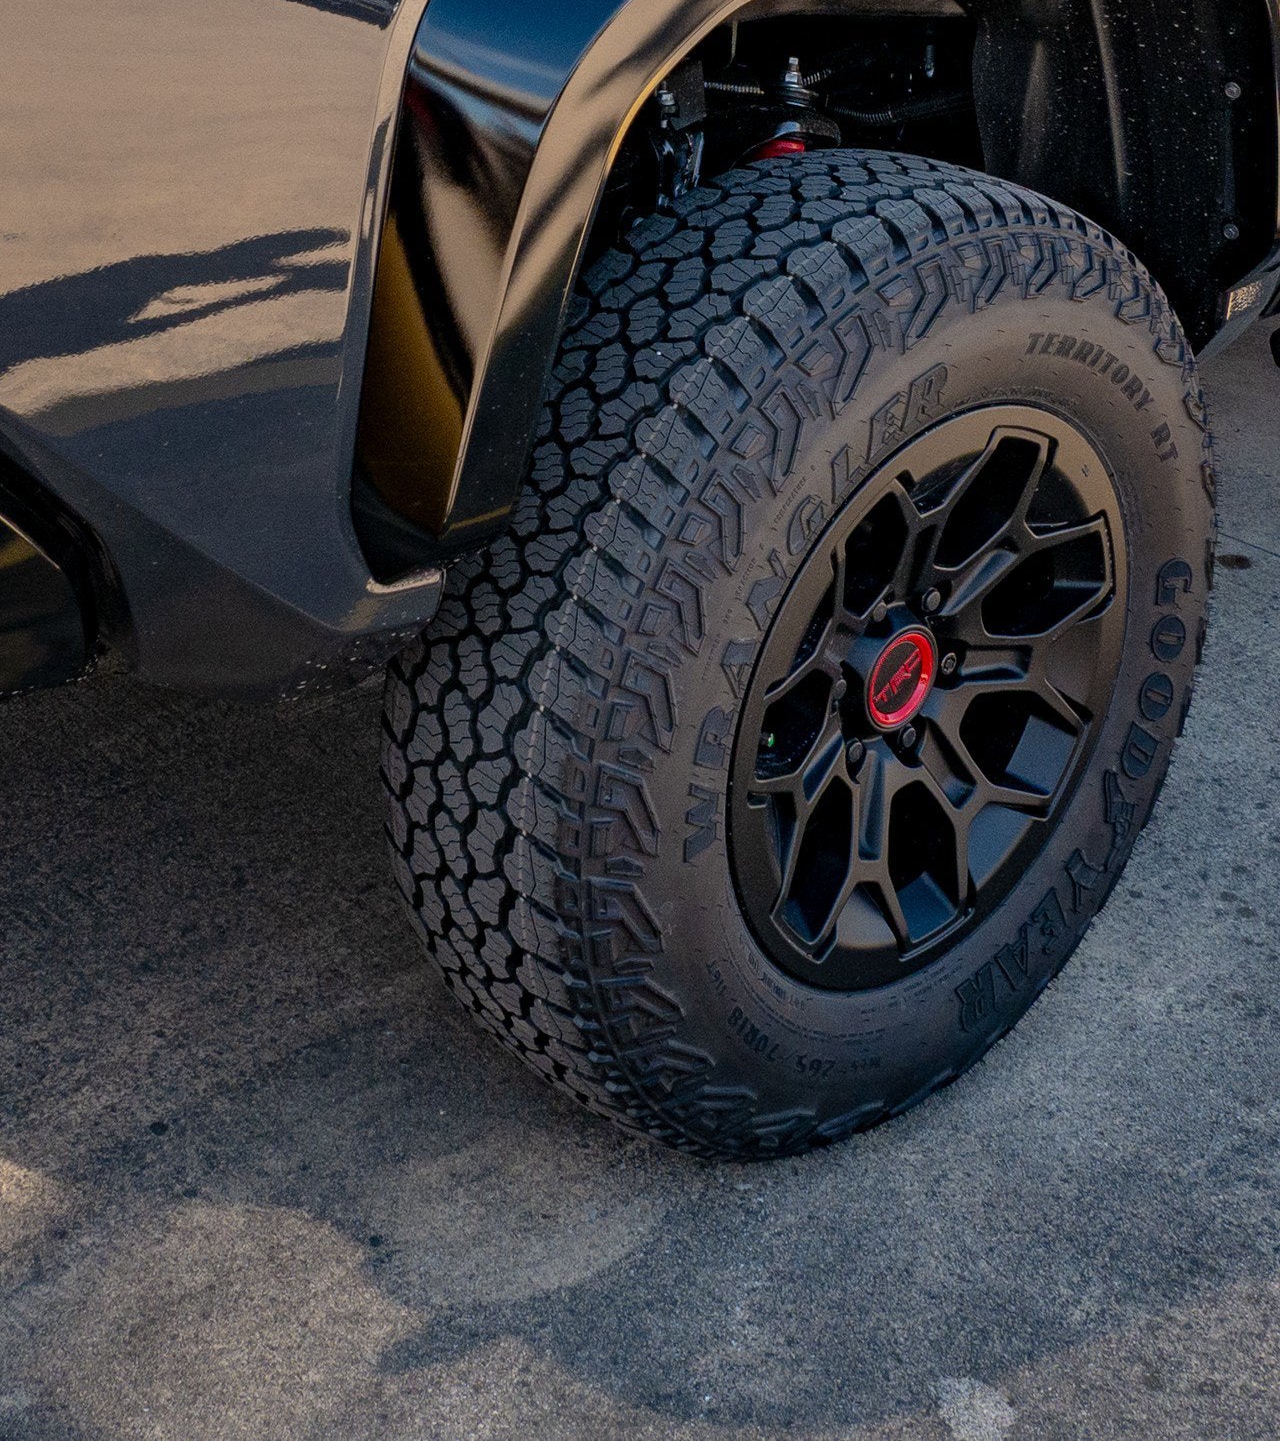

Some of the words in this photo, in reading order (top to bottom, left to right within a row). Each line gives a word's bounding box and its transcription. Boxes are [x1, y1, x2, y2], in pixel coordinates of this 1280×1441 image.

[1024, 332, 1155, 411] TERRITORY
[1150, 422, 1179, 462] RT
[683, 362, 949, 864] WRANGLER
[873, 648, 921, 702] TRD
[953, 559, 1192, 1034] GOODYEAR
